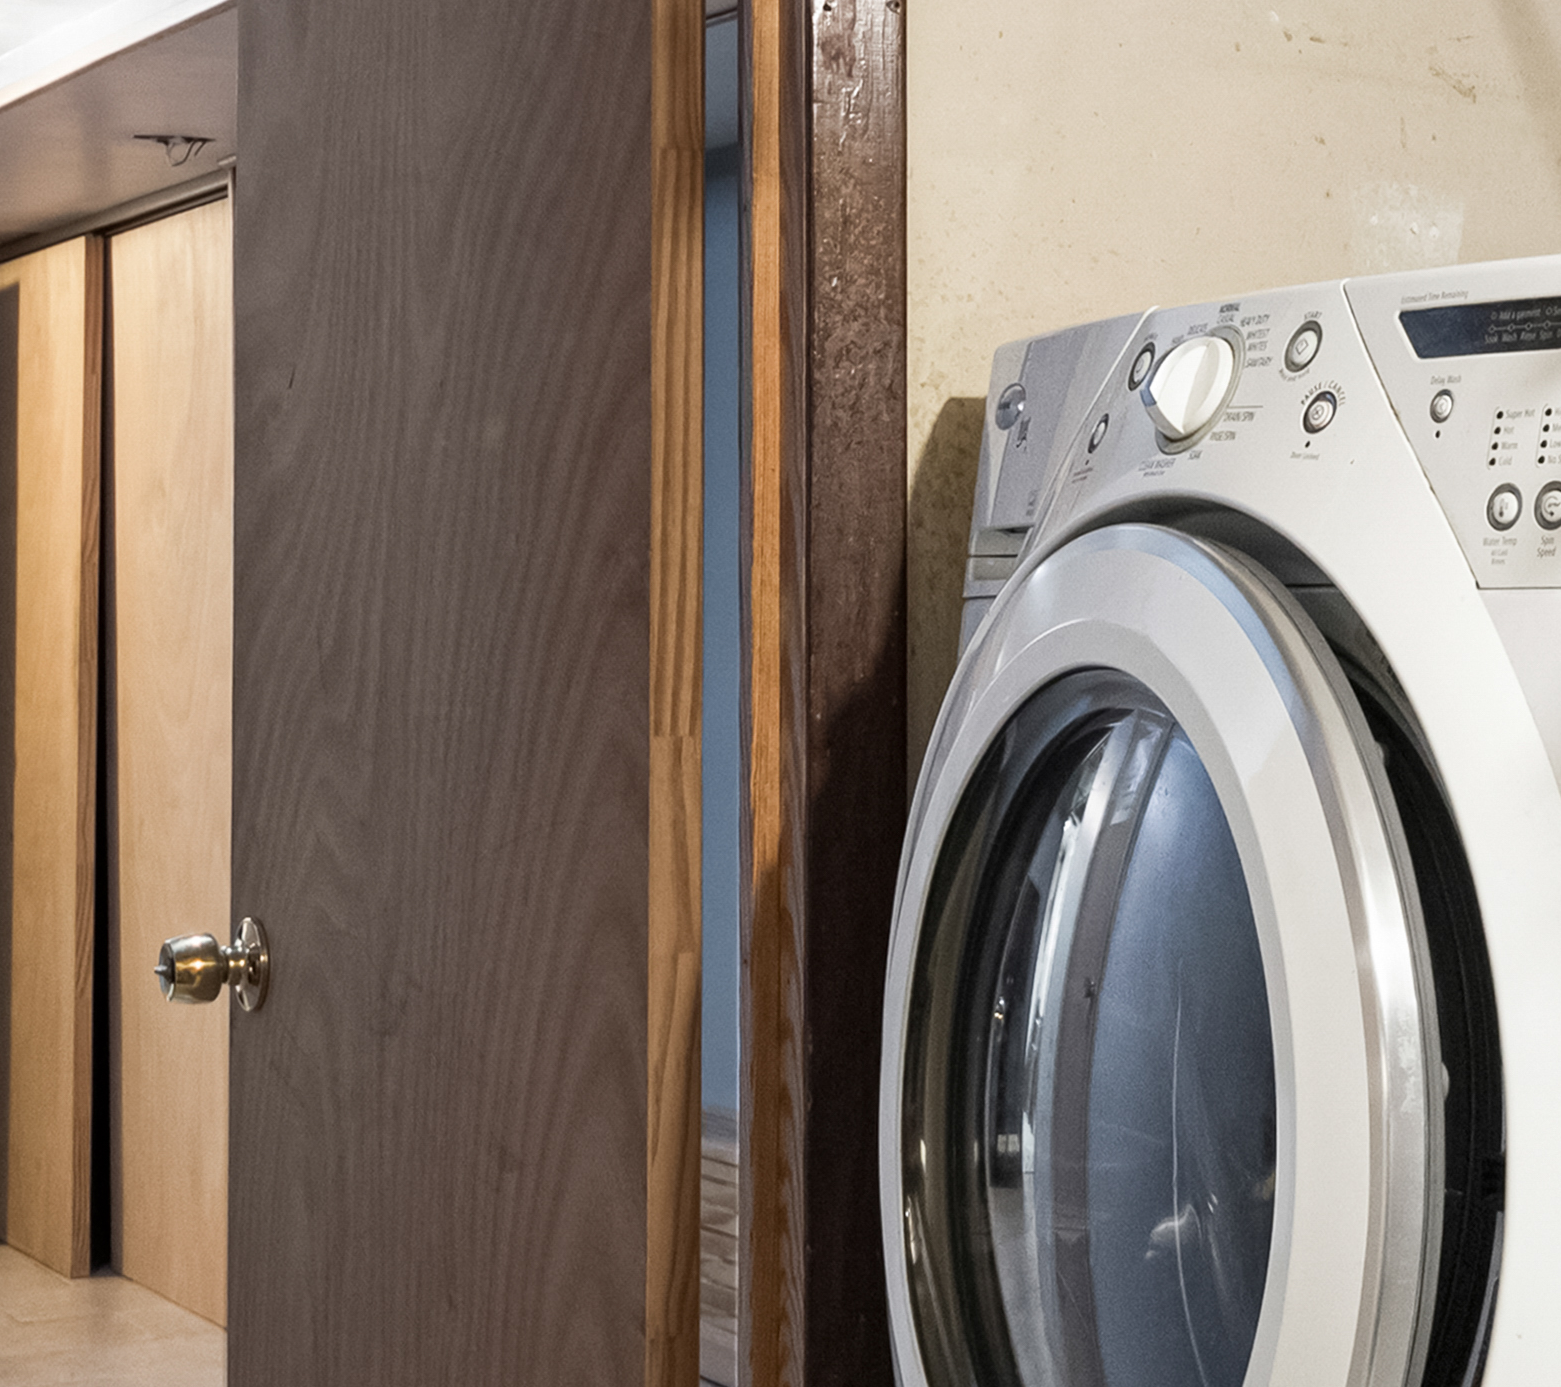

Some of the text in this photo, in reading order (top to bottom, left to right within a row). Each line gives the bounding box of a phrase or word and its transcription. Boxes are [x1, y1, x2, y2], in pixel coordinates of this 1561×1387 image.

[1430, 374, 1462, 387] Delay Wash
[1506, 408, 1536, 420] Super Hot
[1549, 439, 1561, 449] Low
[1547, 454, 1557, 464] No
[1540, 535, 1556, 547] Spin
[1536, 545, 1557, 559] Speed
